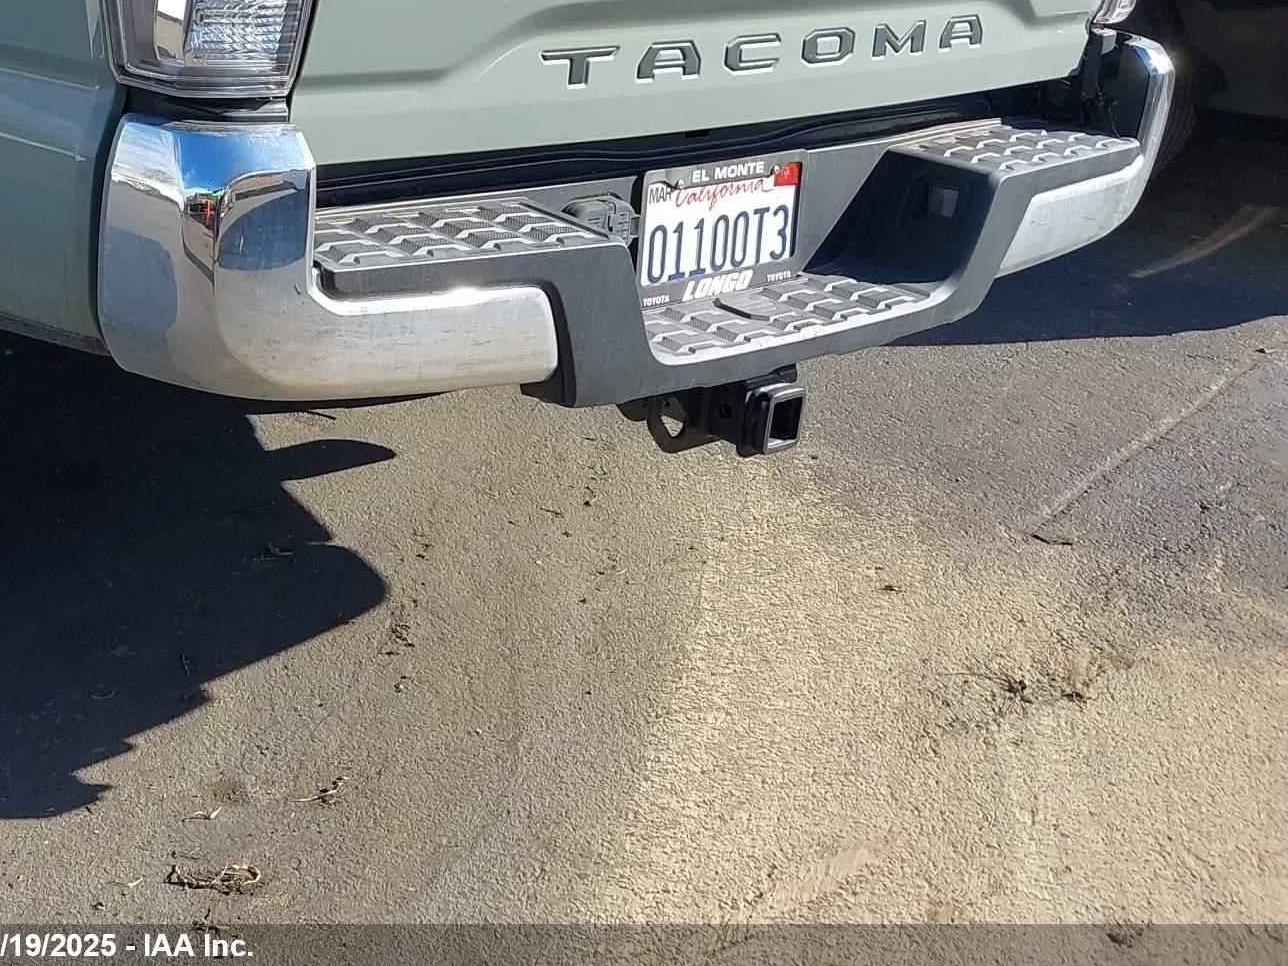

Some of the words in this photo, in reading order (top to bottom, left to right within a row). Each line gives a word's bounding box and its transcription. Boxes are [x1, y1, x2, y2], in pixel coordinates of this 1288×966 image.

[540, 14, 984, 90] TACOMA
[692, 169, 710, 183] EL
[714, 161, 766, 180] MONTE
[648, 186, 673, 204] MAR
[675, 178, 774, 211] California
[647, 204, 790, 284] 01100T3
[681, 269, 754, 302] LONGO
[766, 270, 792, 283] TOYOTA
[642, 294, 670, 307] TOYOTA
